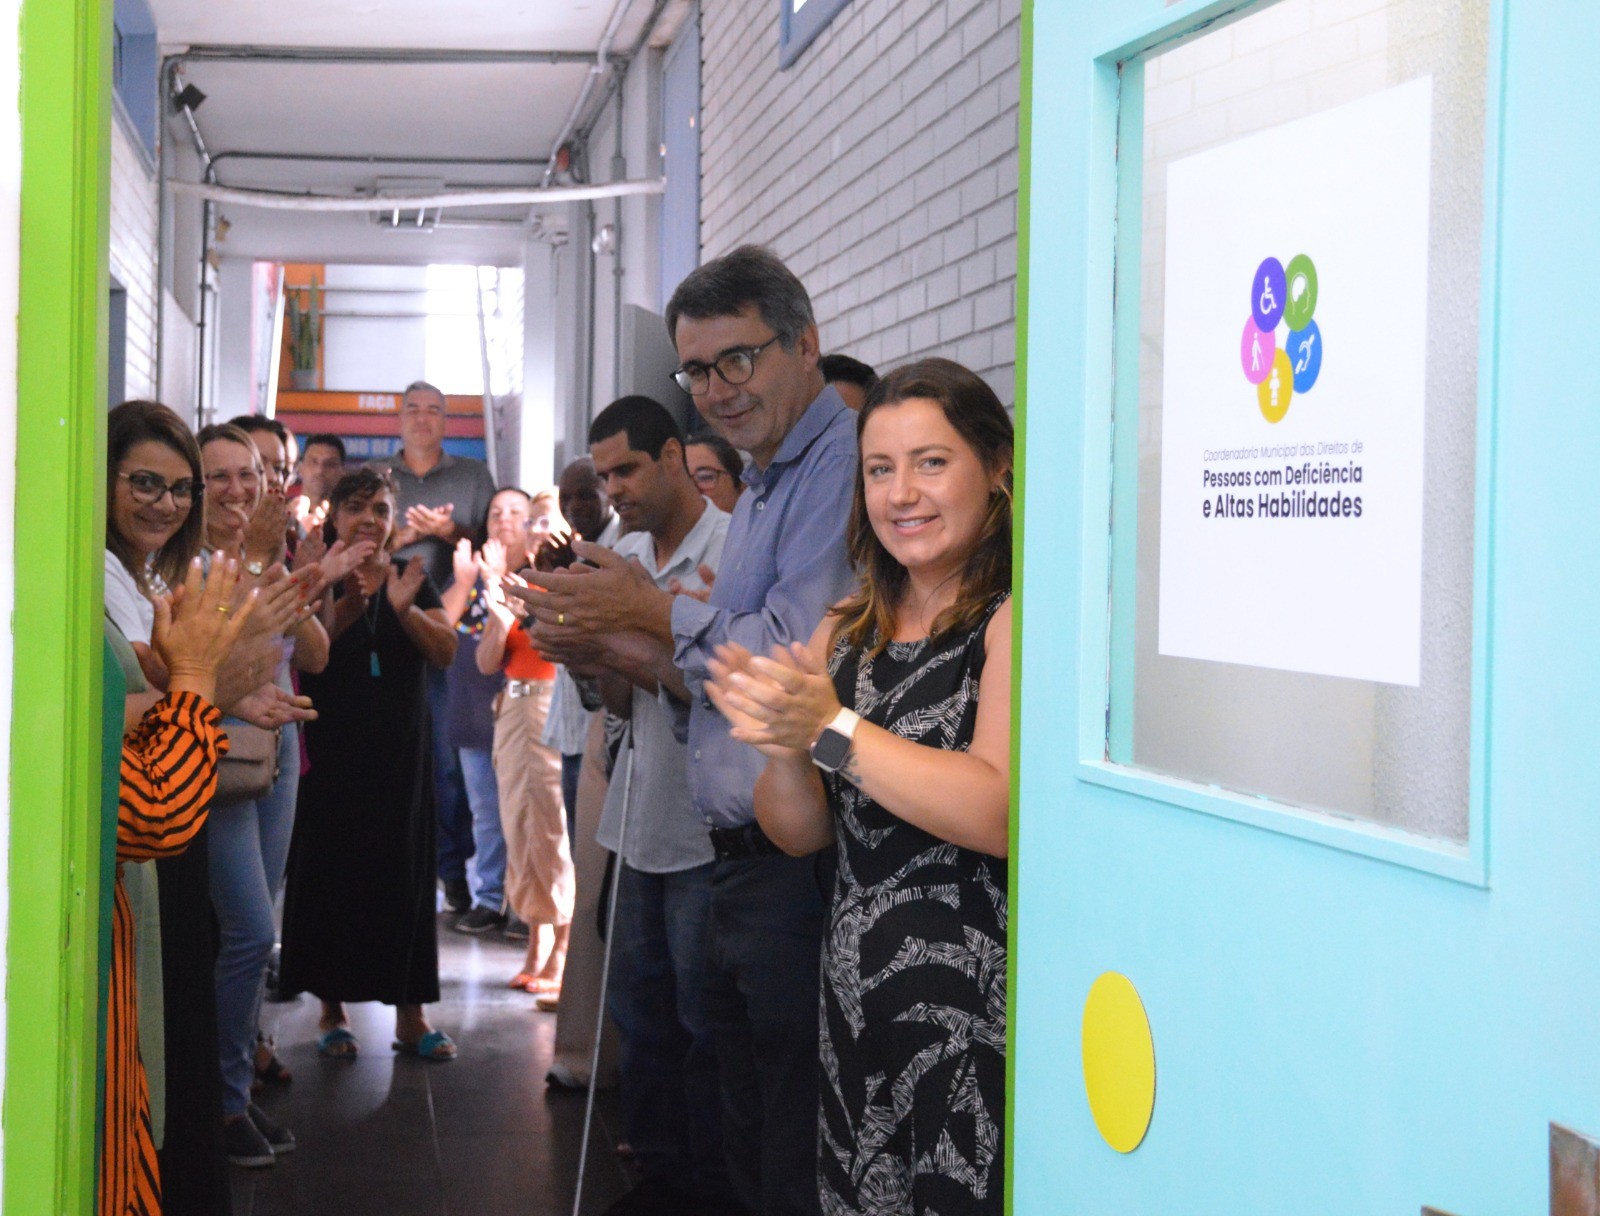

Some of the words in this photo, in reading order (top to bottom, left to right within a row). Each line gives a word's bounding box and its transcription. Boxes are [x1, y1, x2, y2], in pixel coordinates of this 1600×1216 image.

[358, 394, 395, 411] FAÇA
[1203, 446, 1258, 462] Coordenadoria
[1260, 442, 1298, 462] Municipal
[1300, 443, 1315, 456] dos
[1317, 440, 1348, 456] Direitos
[1351, 439, 1363, 454] de
[1203, 469, 1251, 488] Pessoas
[1254, 470, 1282, 486] com
[1285, 460, 1363, 485] Deficiência
[1202, 499, 1211, 518] e
[1214, 493, 1254, 518] Altas
[1258, 490, 1363, 518] Habilidades
